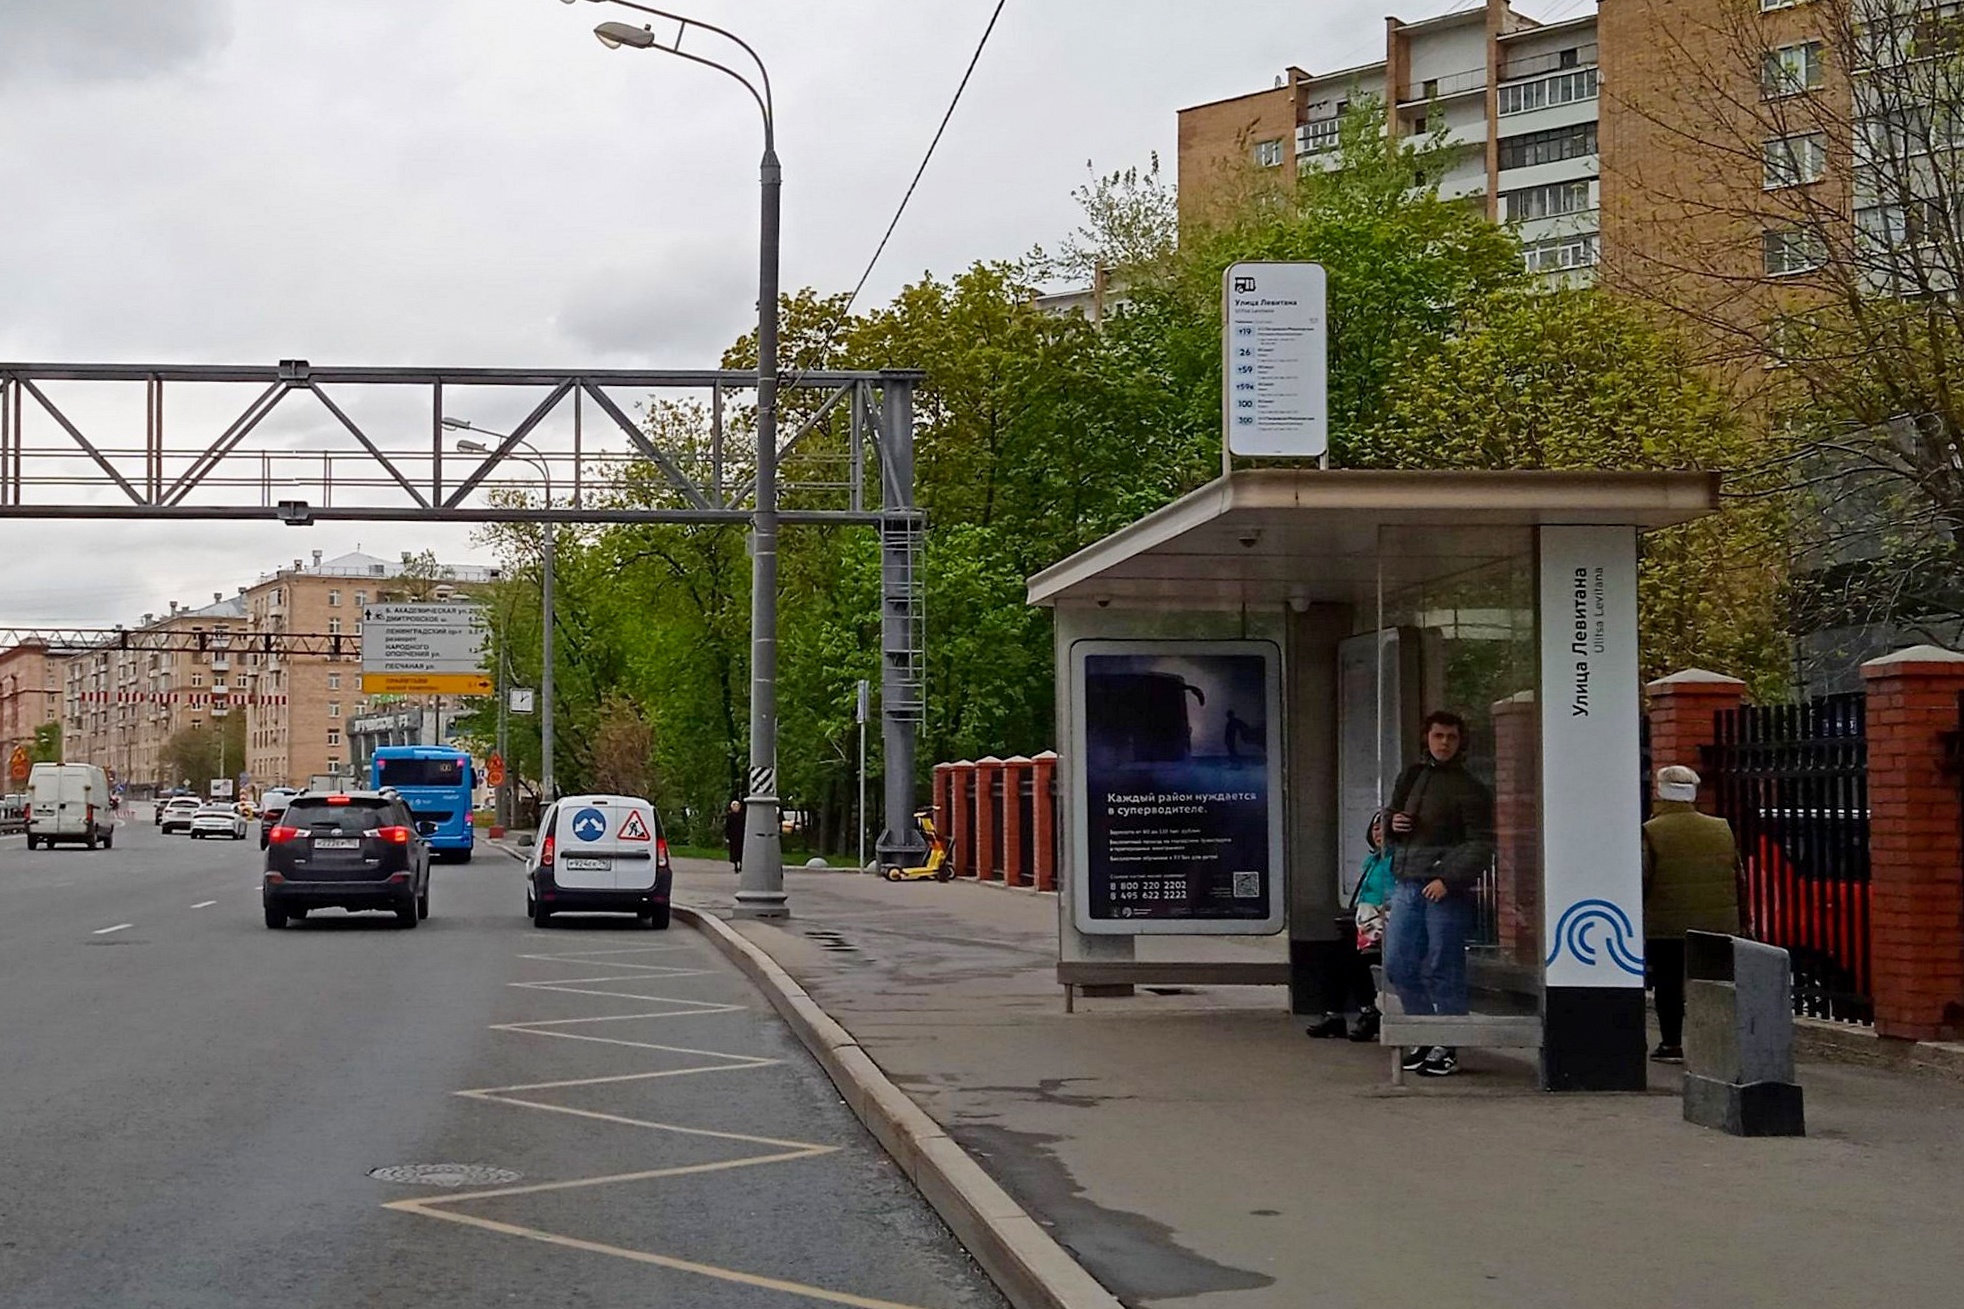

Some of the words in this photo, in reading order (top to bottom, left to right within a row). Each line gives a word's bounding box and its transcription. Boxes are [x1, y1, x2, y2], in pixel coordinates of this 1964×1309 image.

[1238, 366, 1253, 374] т59
[1594, 567, 1604, 617] Levitana
[1572, 567, 1588, 656] Левитана
[1594, 621, 1604, 654] Ulitsa
[1572, 662, 1590, 716] Улица
[1108, 792, 1155, 803] Каждый
[1158, 792, 1193, 803] район
[1195, 792, 1257, 802] нуждается
[1118, 805, 1208, 816] суперводителе.
[1110, 882, 1116, 890] 8
[1120, 882, 1138, 890] 800
[1164, 881, 1187, 889] 2202
[1110, 892, 1116, 900] 8
[1164, 890, 1187, 899] 2222
